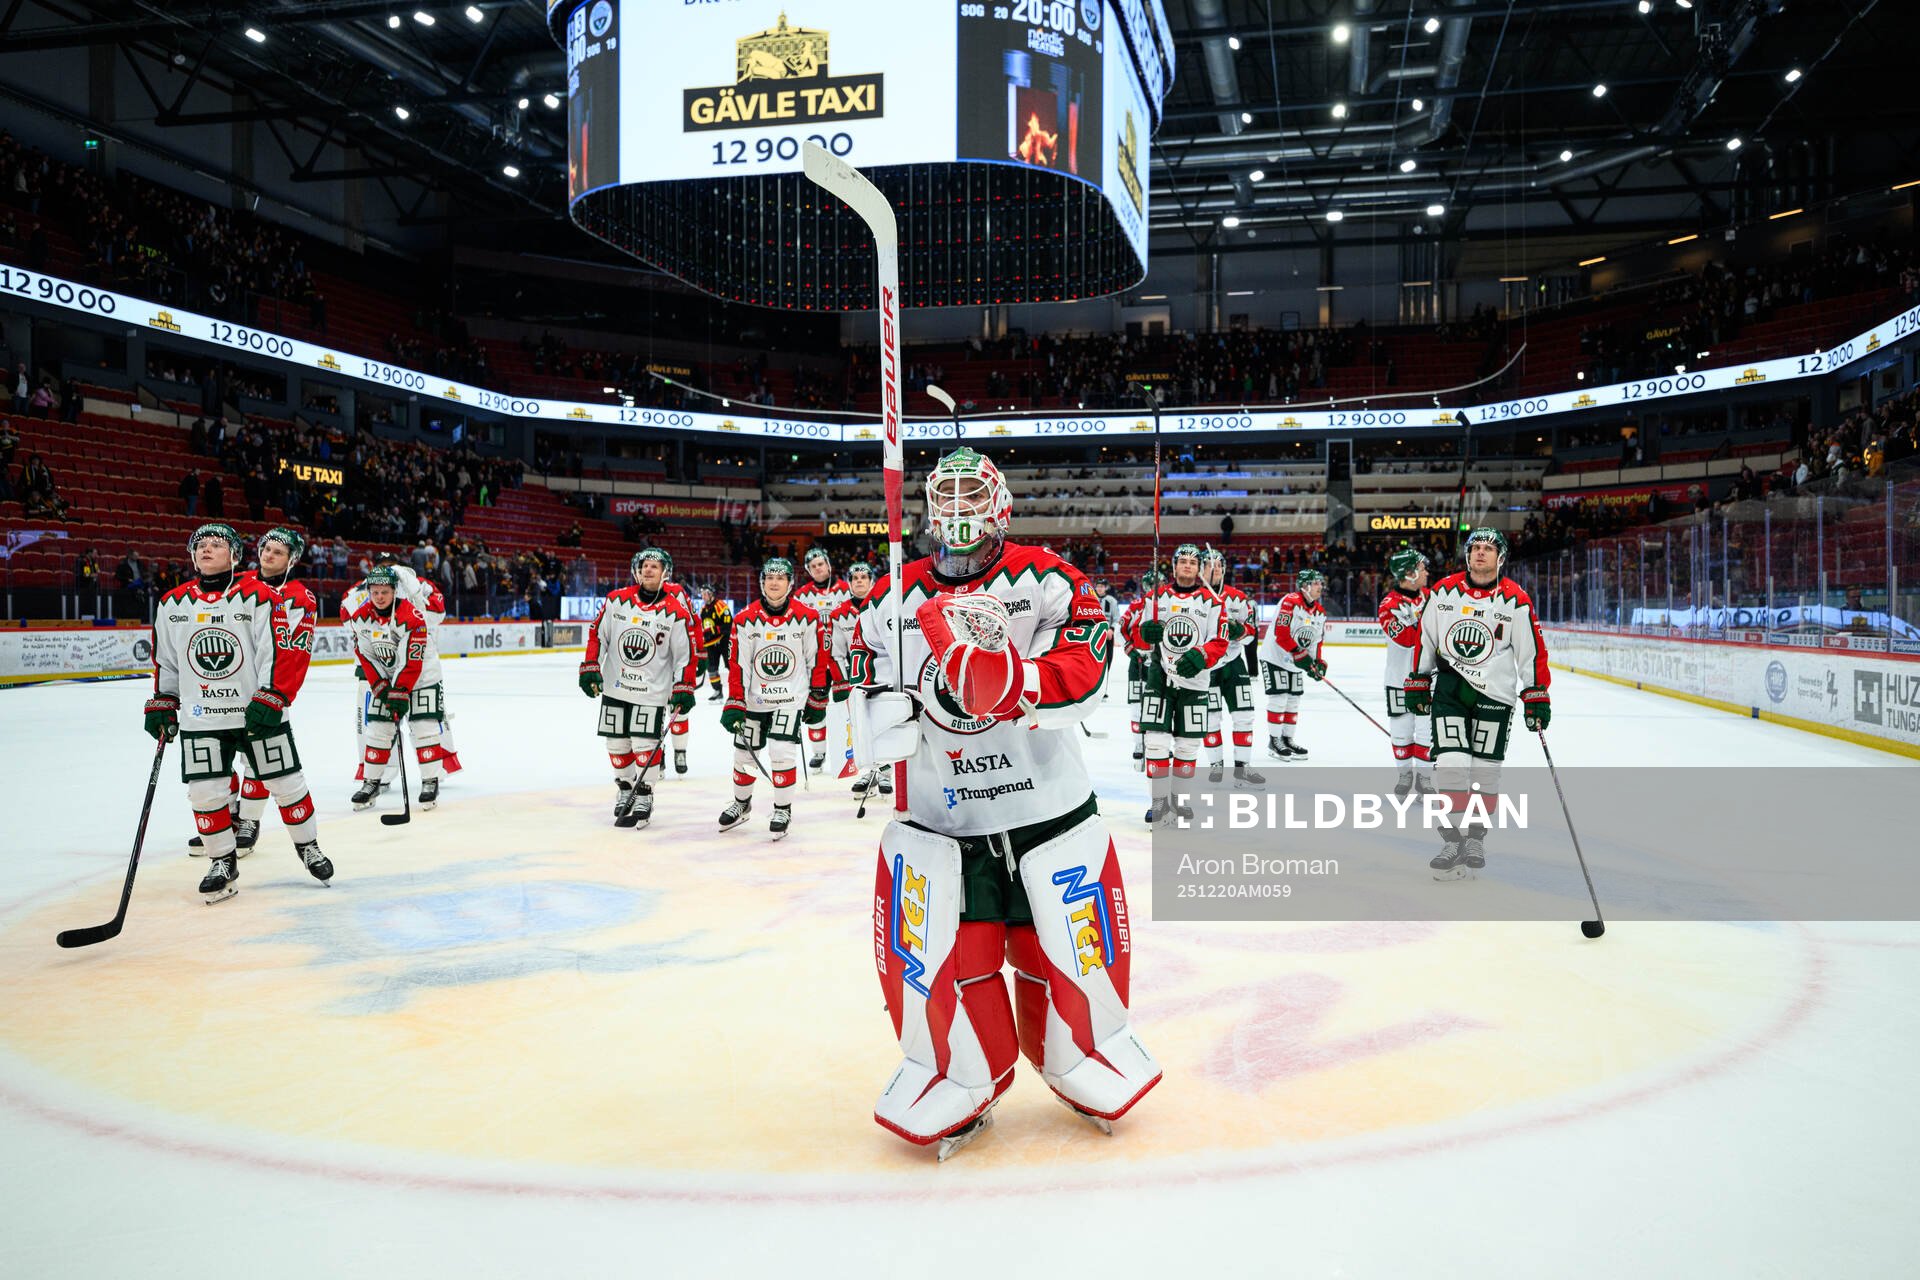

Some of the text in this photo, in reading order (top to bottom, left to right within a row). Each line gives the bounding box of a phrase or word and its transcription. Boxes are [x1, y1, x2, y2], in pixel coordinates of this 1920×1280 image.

[961, 4, 984, 17] SOG
[1012, 0, 1076, 36] 20:00
[1028, 28, 1064, 47] nordic
[690, 84, 876, 126] GÄVLE TAXI
[712, 140, 748, 165] 12
[882, 286, 897, 448] BAUER
[313, 466, 343, 486] TAXI
[828, 521, 890, 534] GÄVLE TAX
[1371, 514, 1451, 530] GÄVLE TAXI
[1008, 605, 1032, 617] greven
[1012, 598, 1030, 607] Kaffe
[902, 623, 921, 632] reve
[1387, 620, 1404, 639] 43
[474, 628, 502, 649] nds
[656, 632, 665, 645] C
[924, 658, 940, 682] FRÖL
[1453, 660, 1482, 678] RASTA
[202, 688, 239, 698] RASTA
[204, 706, 246, 715] Tranpena
[952, 754, 1012, 776] RASTA
[957, 778, 1034, 801] Tranpenad
[1112, 888, 1130, 954] BAUER
[876, 896, 887, 975] BAUER
